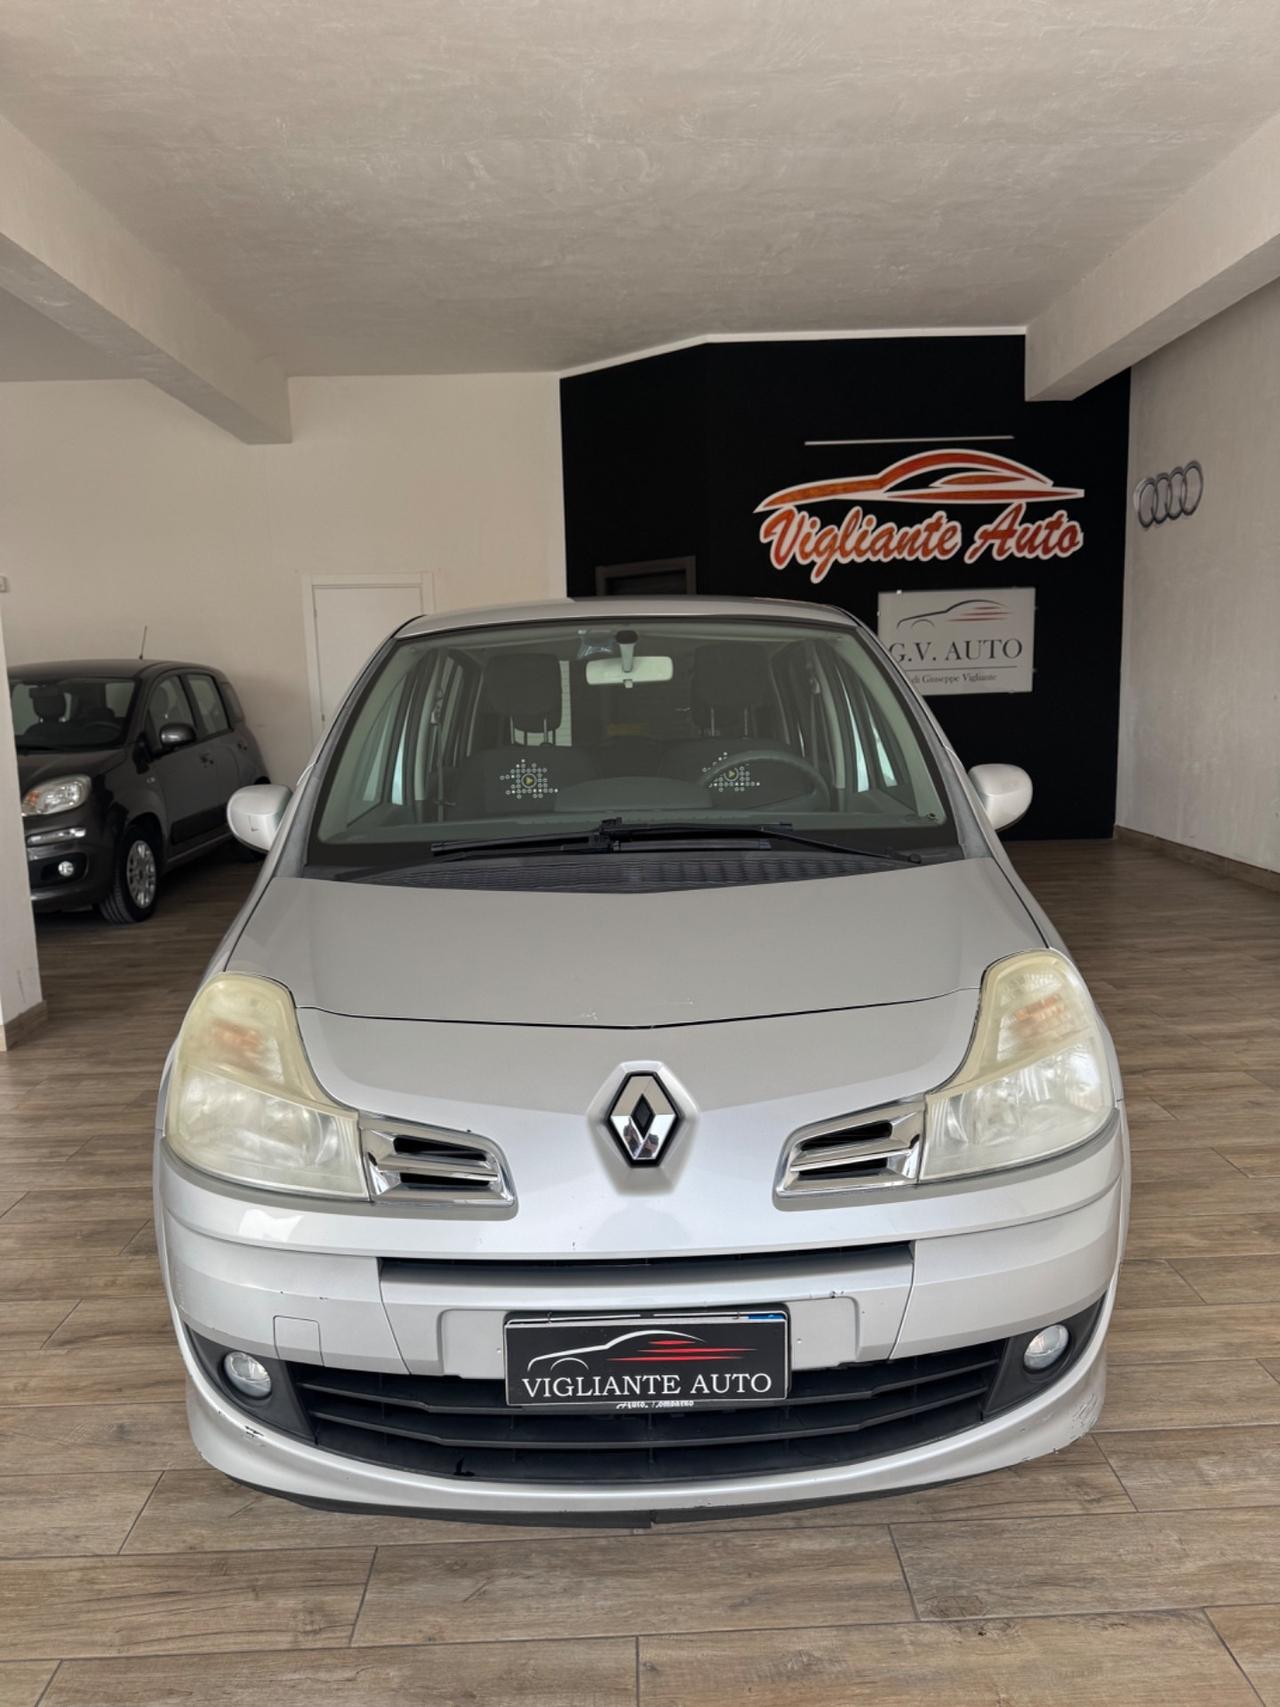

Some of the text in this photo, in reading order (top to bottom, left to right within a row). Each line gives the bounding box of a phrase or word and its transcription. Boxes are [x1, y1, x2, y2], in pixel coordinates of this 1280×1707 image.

[760, 501, 1083, 583] Vigliante Auto
[889, 638, 1023, 662] G.V. AUTO
[922, 674, 959, 685] Giuseppe
[962, 673, 997, 683] Vigliante
[522, 1373, 772, 1398] VIGLIANTE AUTO
